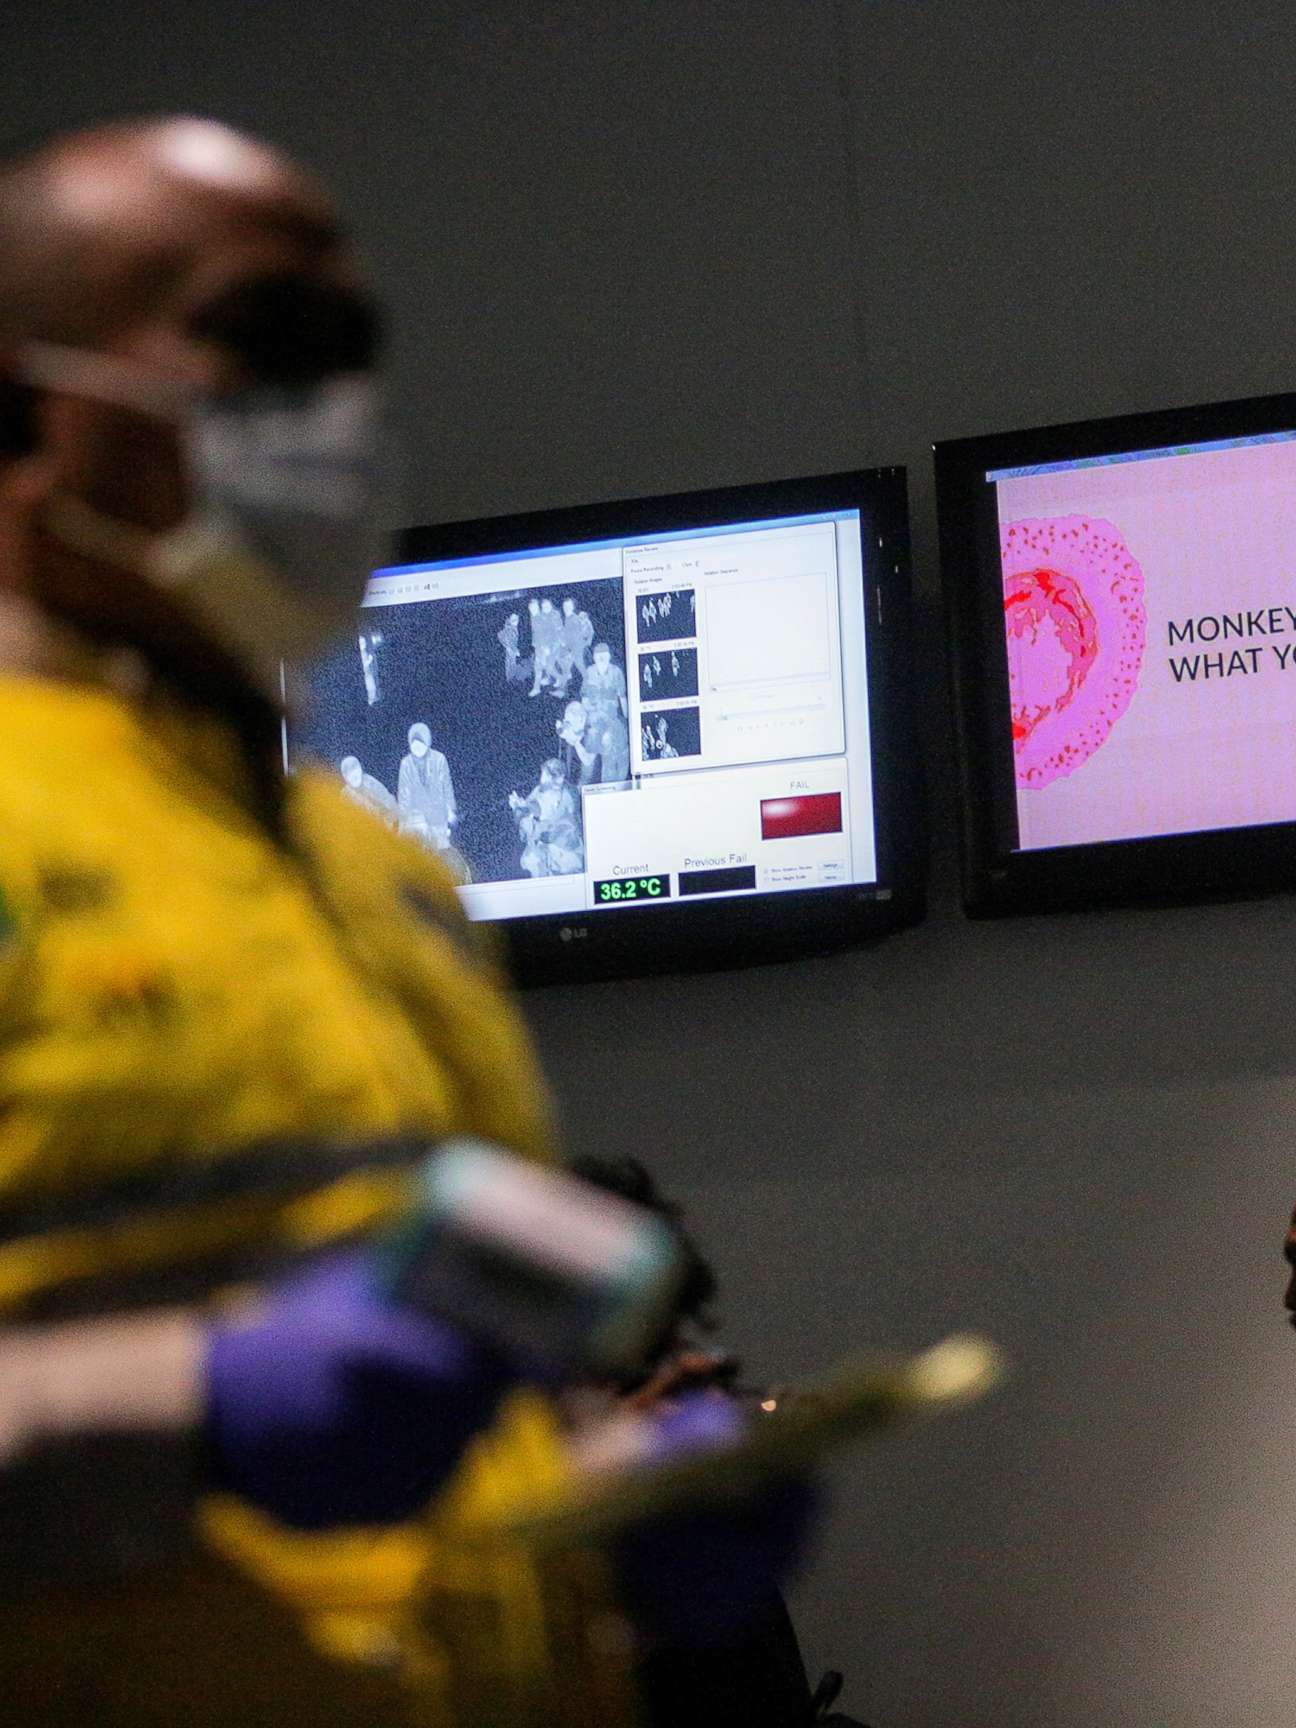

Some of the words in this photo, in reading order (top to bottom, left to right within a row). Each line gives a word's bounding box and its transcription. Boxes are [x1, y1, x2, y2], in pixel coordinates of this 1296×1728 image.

[1168, 647, 1264, 683] WHAT
[790, 780, 810, 790] FAIL
[684, 855, 726, 868] Previous
[728, 852, 748, 865] Fail
[612, 862, 650, 876] Current
[600, 880, 637, 901] 36.2
[639, 877, 662, 896] °C
